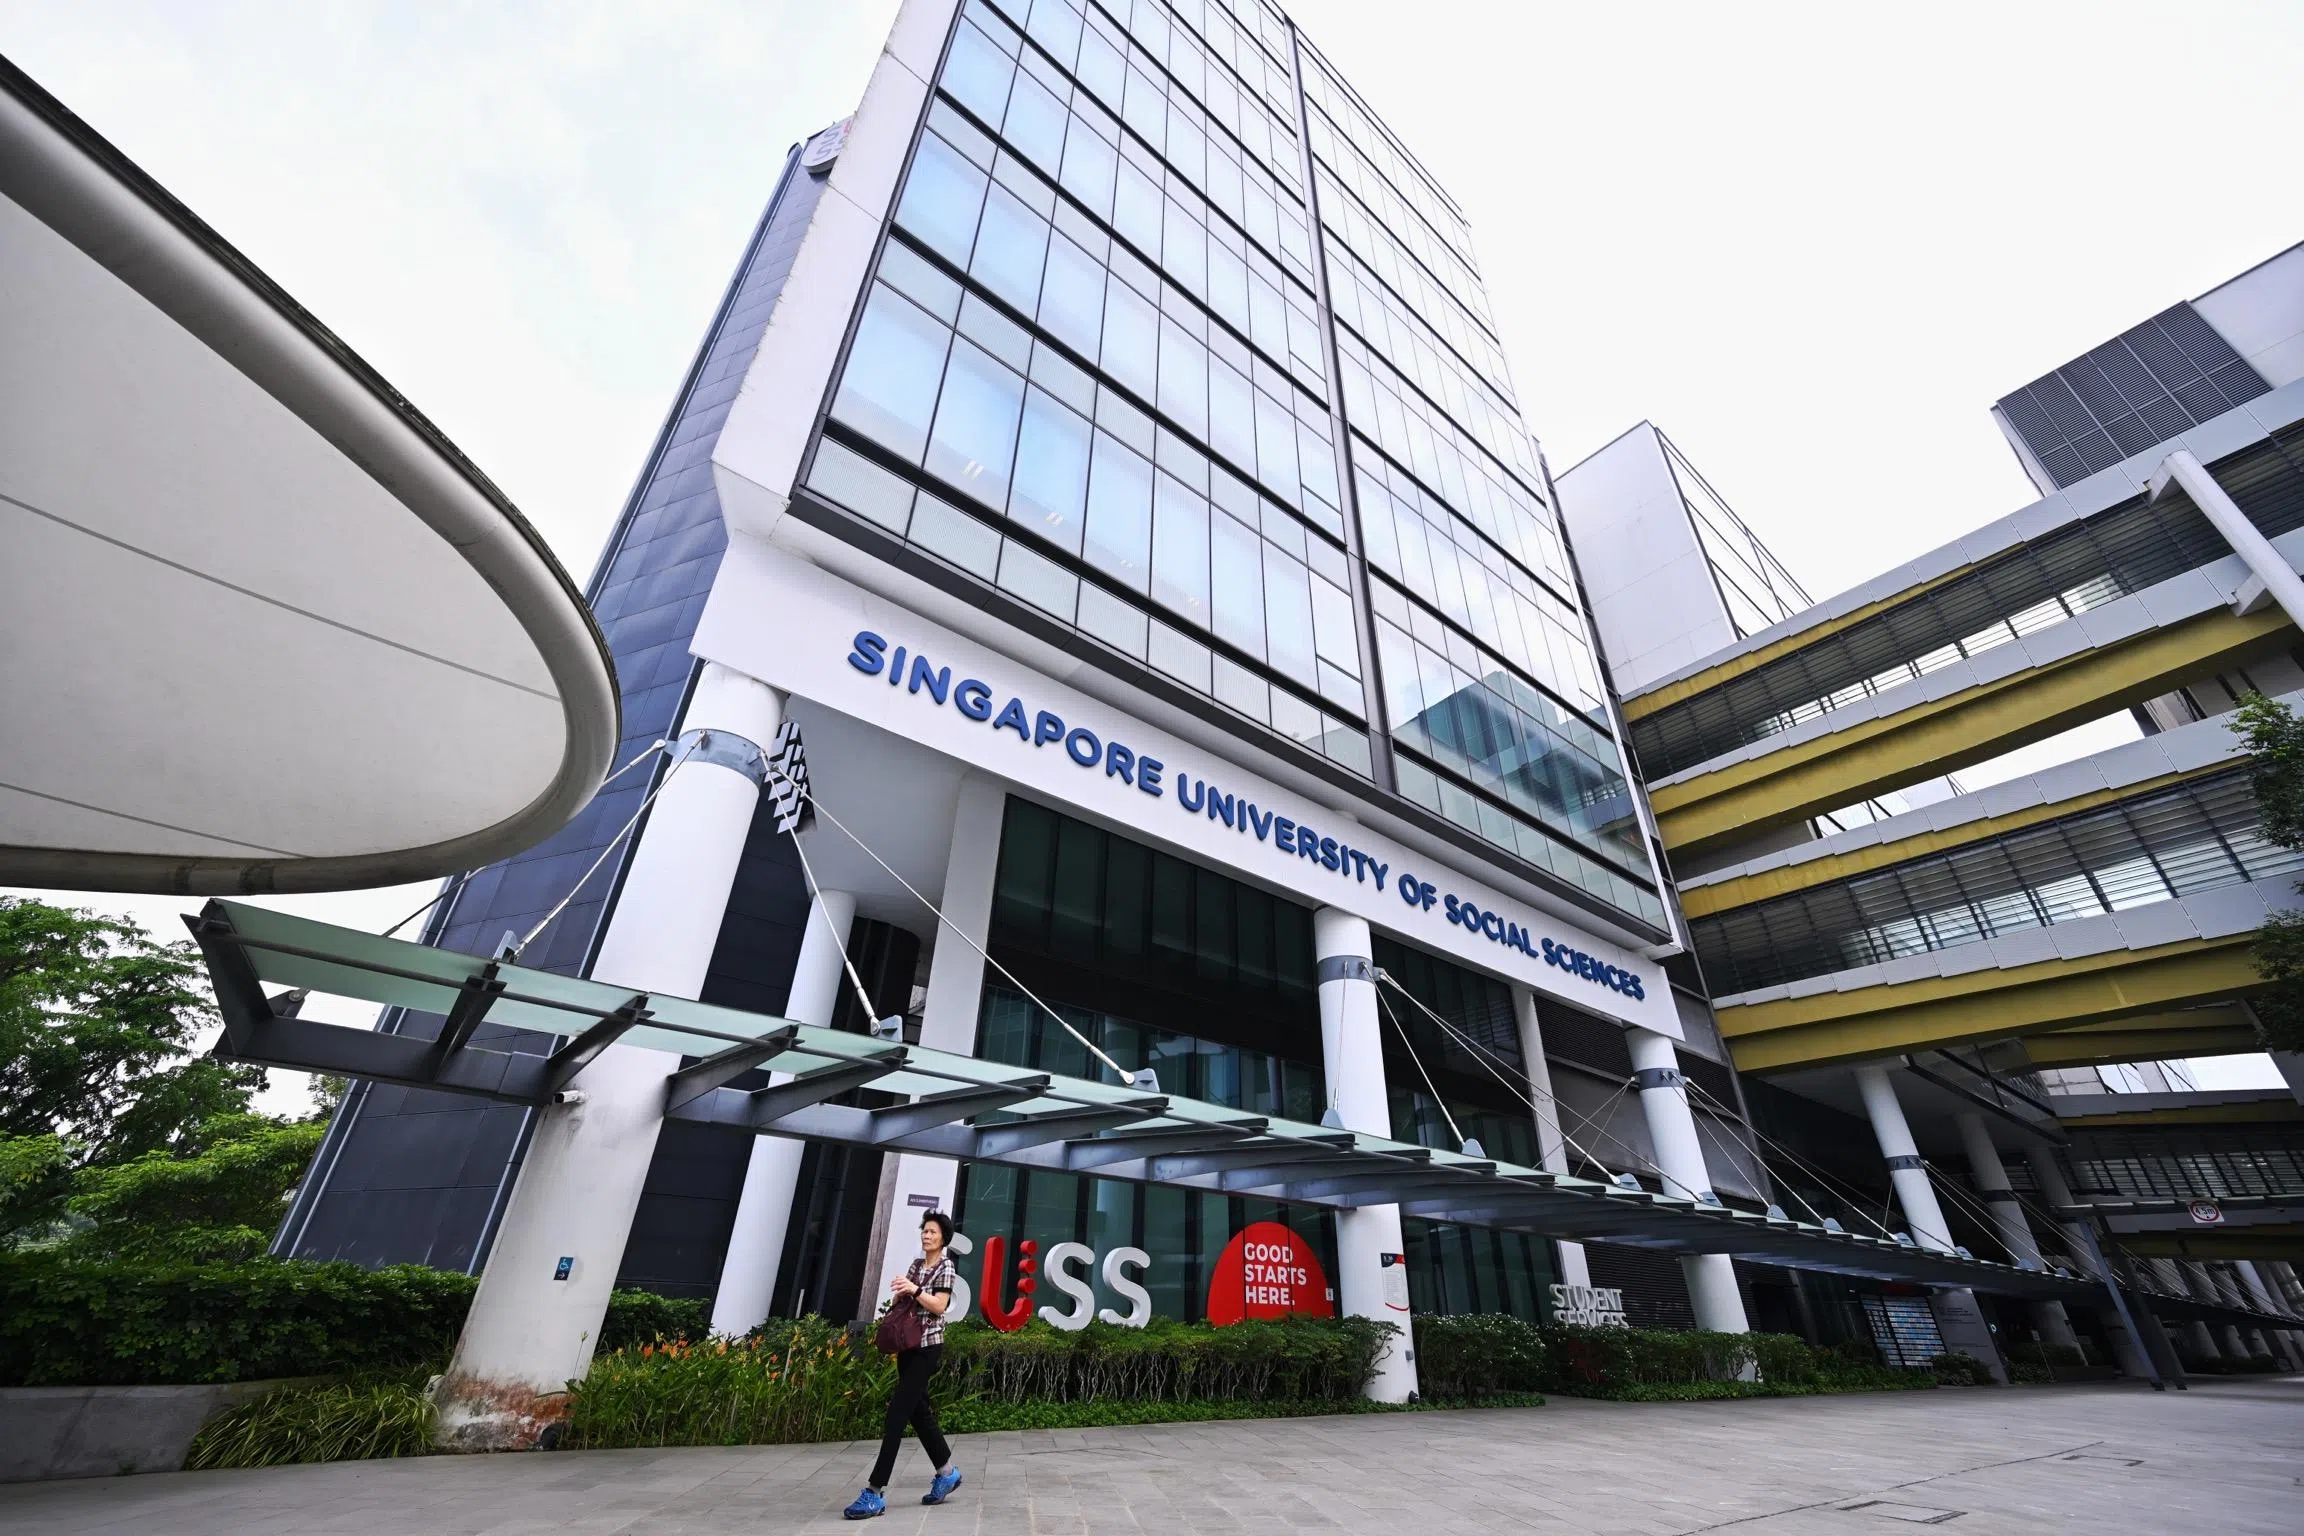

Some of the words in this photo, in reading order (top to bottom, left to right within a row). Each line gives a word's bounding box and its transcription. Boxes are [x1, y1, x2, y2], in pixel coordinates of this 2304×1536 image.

[847, 630, 1165, 797] SINGAPORE
[1177, 773, 1389, 891] UNIVERSITY
[1398, 873, 1437, 912] OF
[1444, 894, 1540, 960] SOCIAL
[1541, 937, 1646, 1001] SCIENCES
[1244, 1242, 1293, 1264] GOOD
[1244, 1263, 1307, 1286] STARTS
[1245, 1285, 1296, 1306] HERE.
[1549, 1283, 1622, 1312] STUDENT
